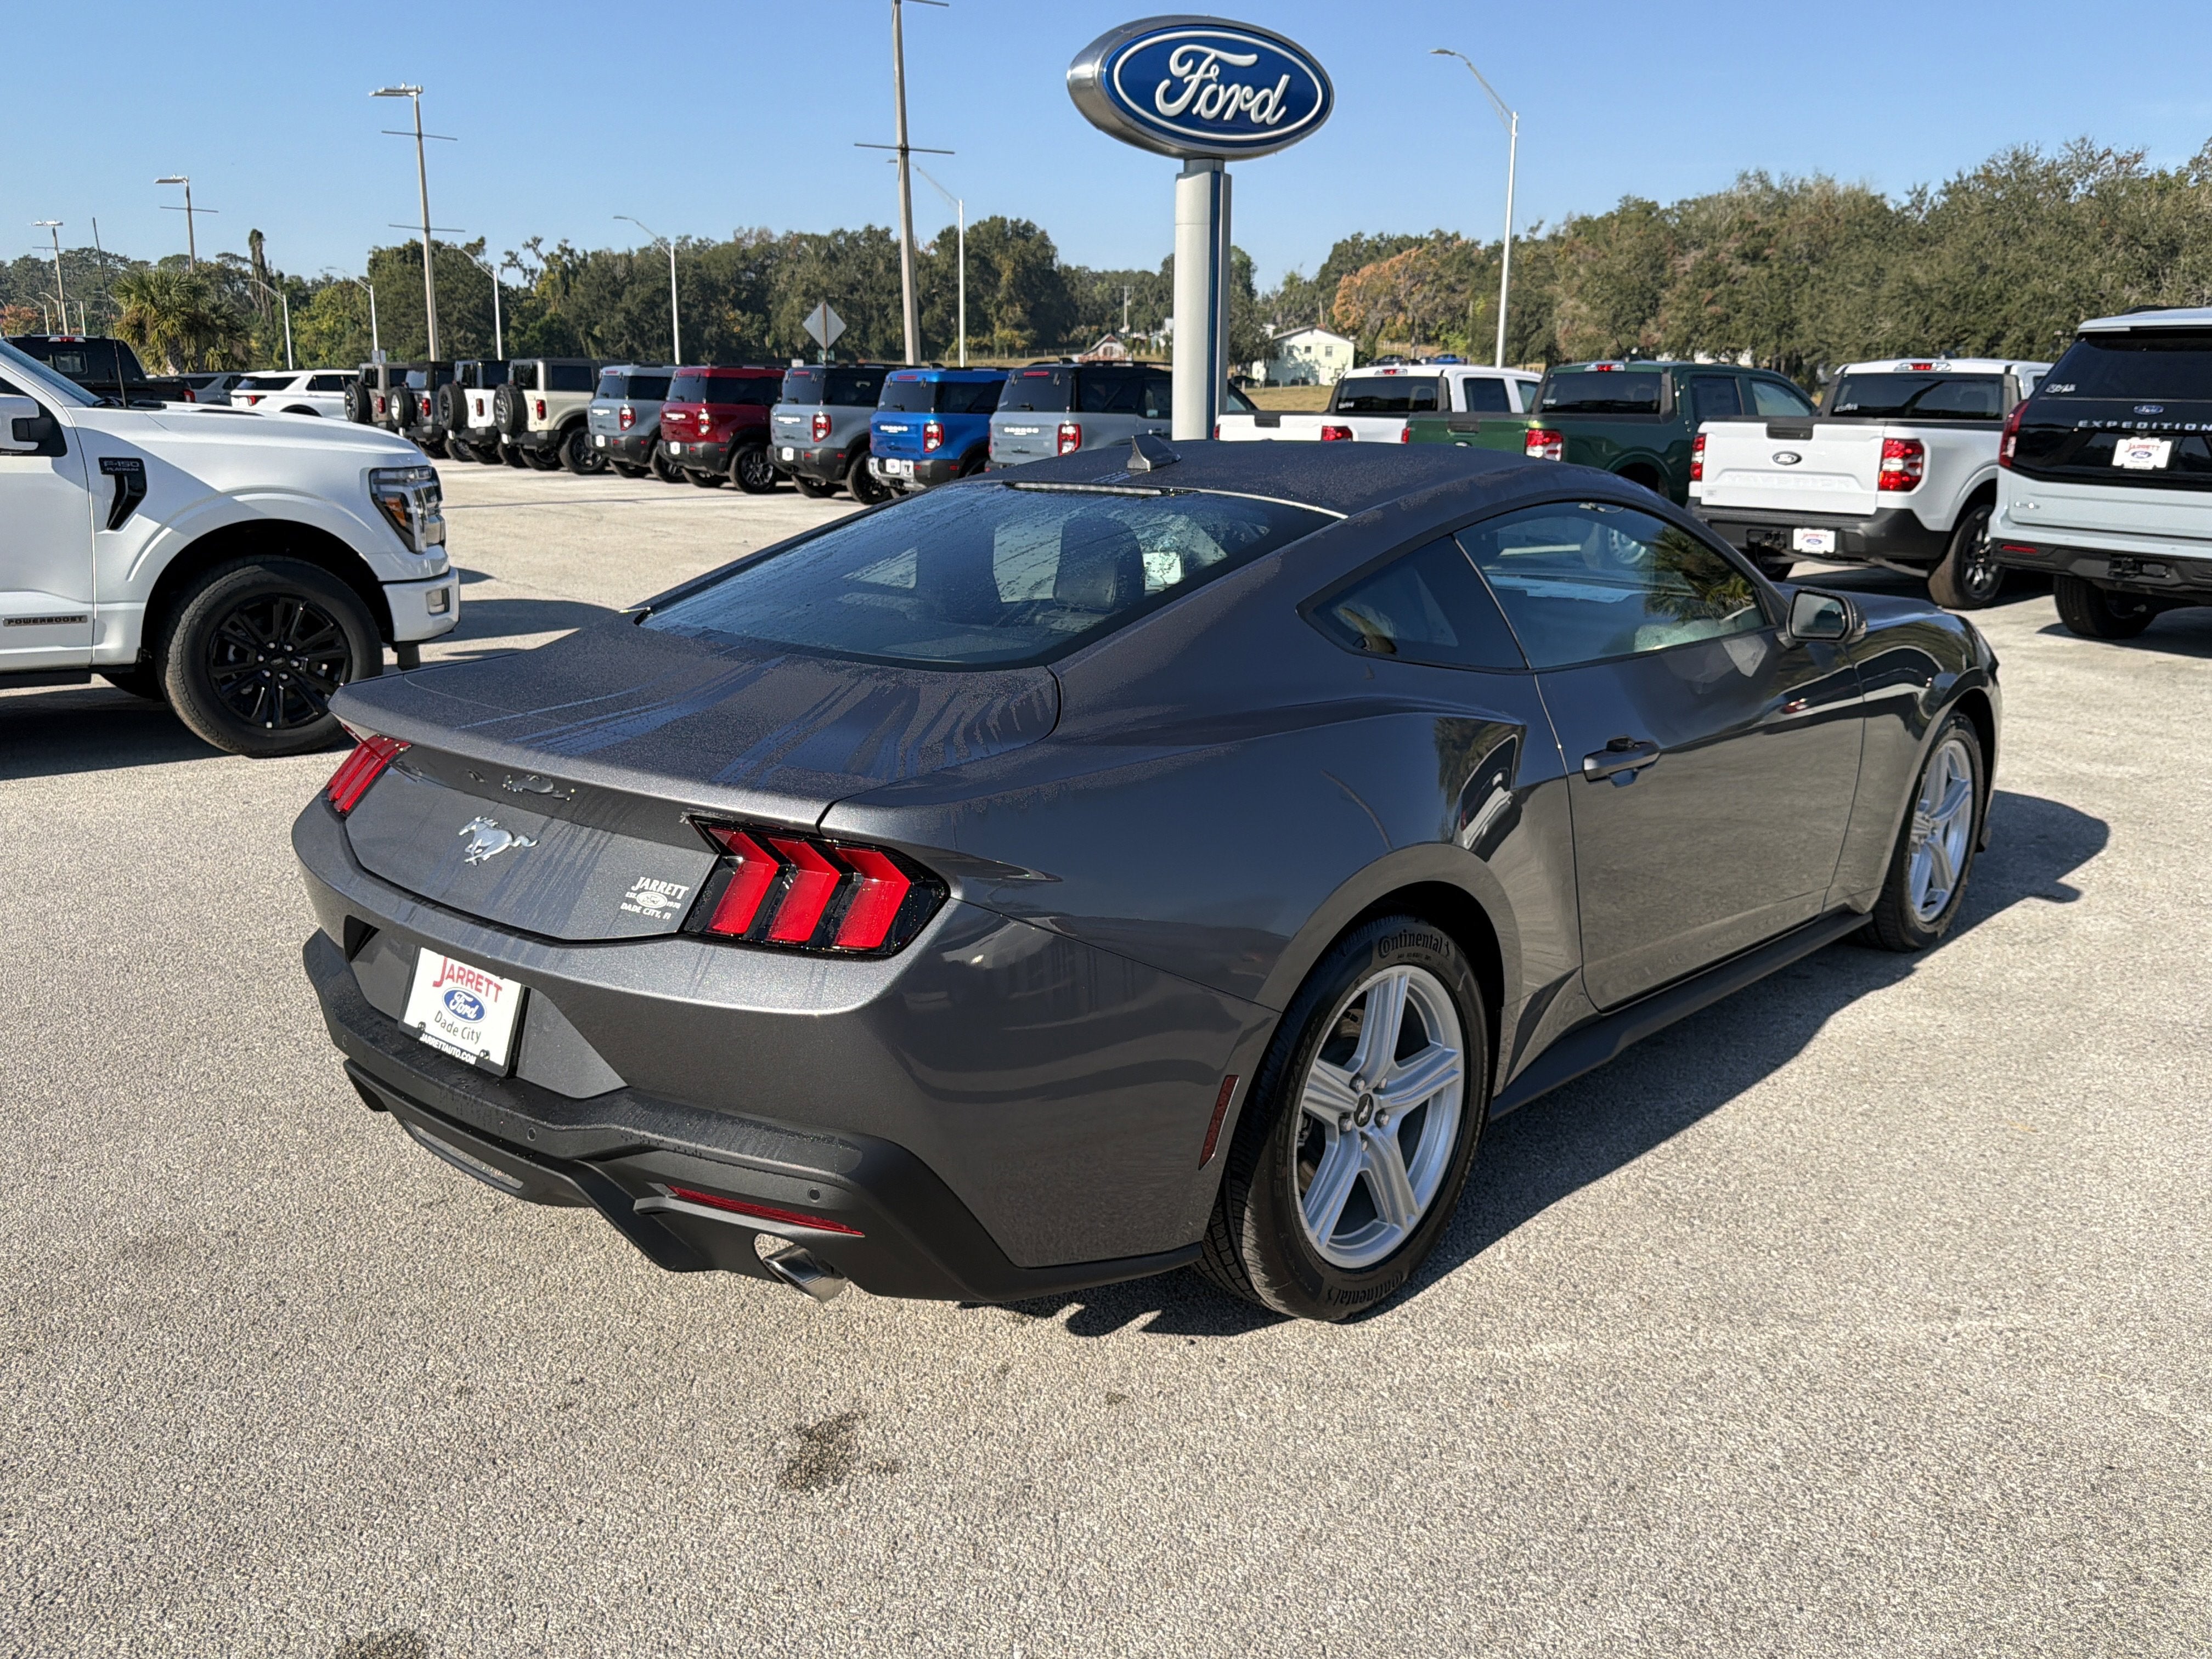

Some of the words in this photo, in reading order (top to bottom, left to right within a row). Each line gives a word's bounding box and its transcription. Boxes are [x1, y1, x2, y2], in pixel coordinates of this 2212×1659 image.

[1155, 44, 1290, 125] Ford
[2078, 420, 2212, 431] EXPEDITION
[7, 616, 83, 625] POWERBOOST
[631, 876, 690, 900] JARRETT
[620, 902, 642, 913] DADE
[1378, 929, 1443, 958] Continental
[432, 956, 503, 1003] JARRETT
[449, 991, 479, 1019] Ford
[434, 1010, 459, 1036] Dade
[461, 1026, 482, 1045] City
[419, 1033, 477, 1065] JARRETTAUTO.COM
